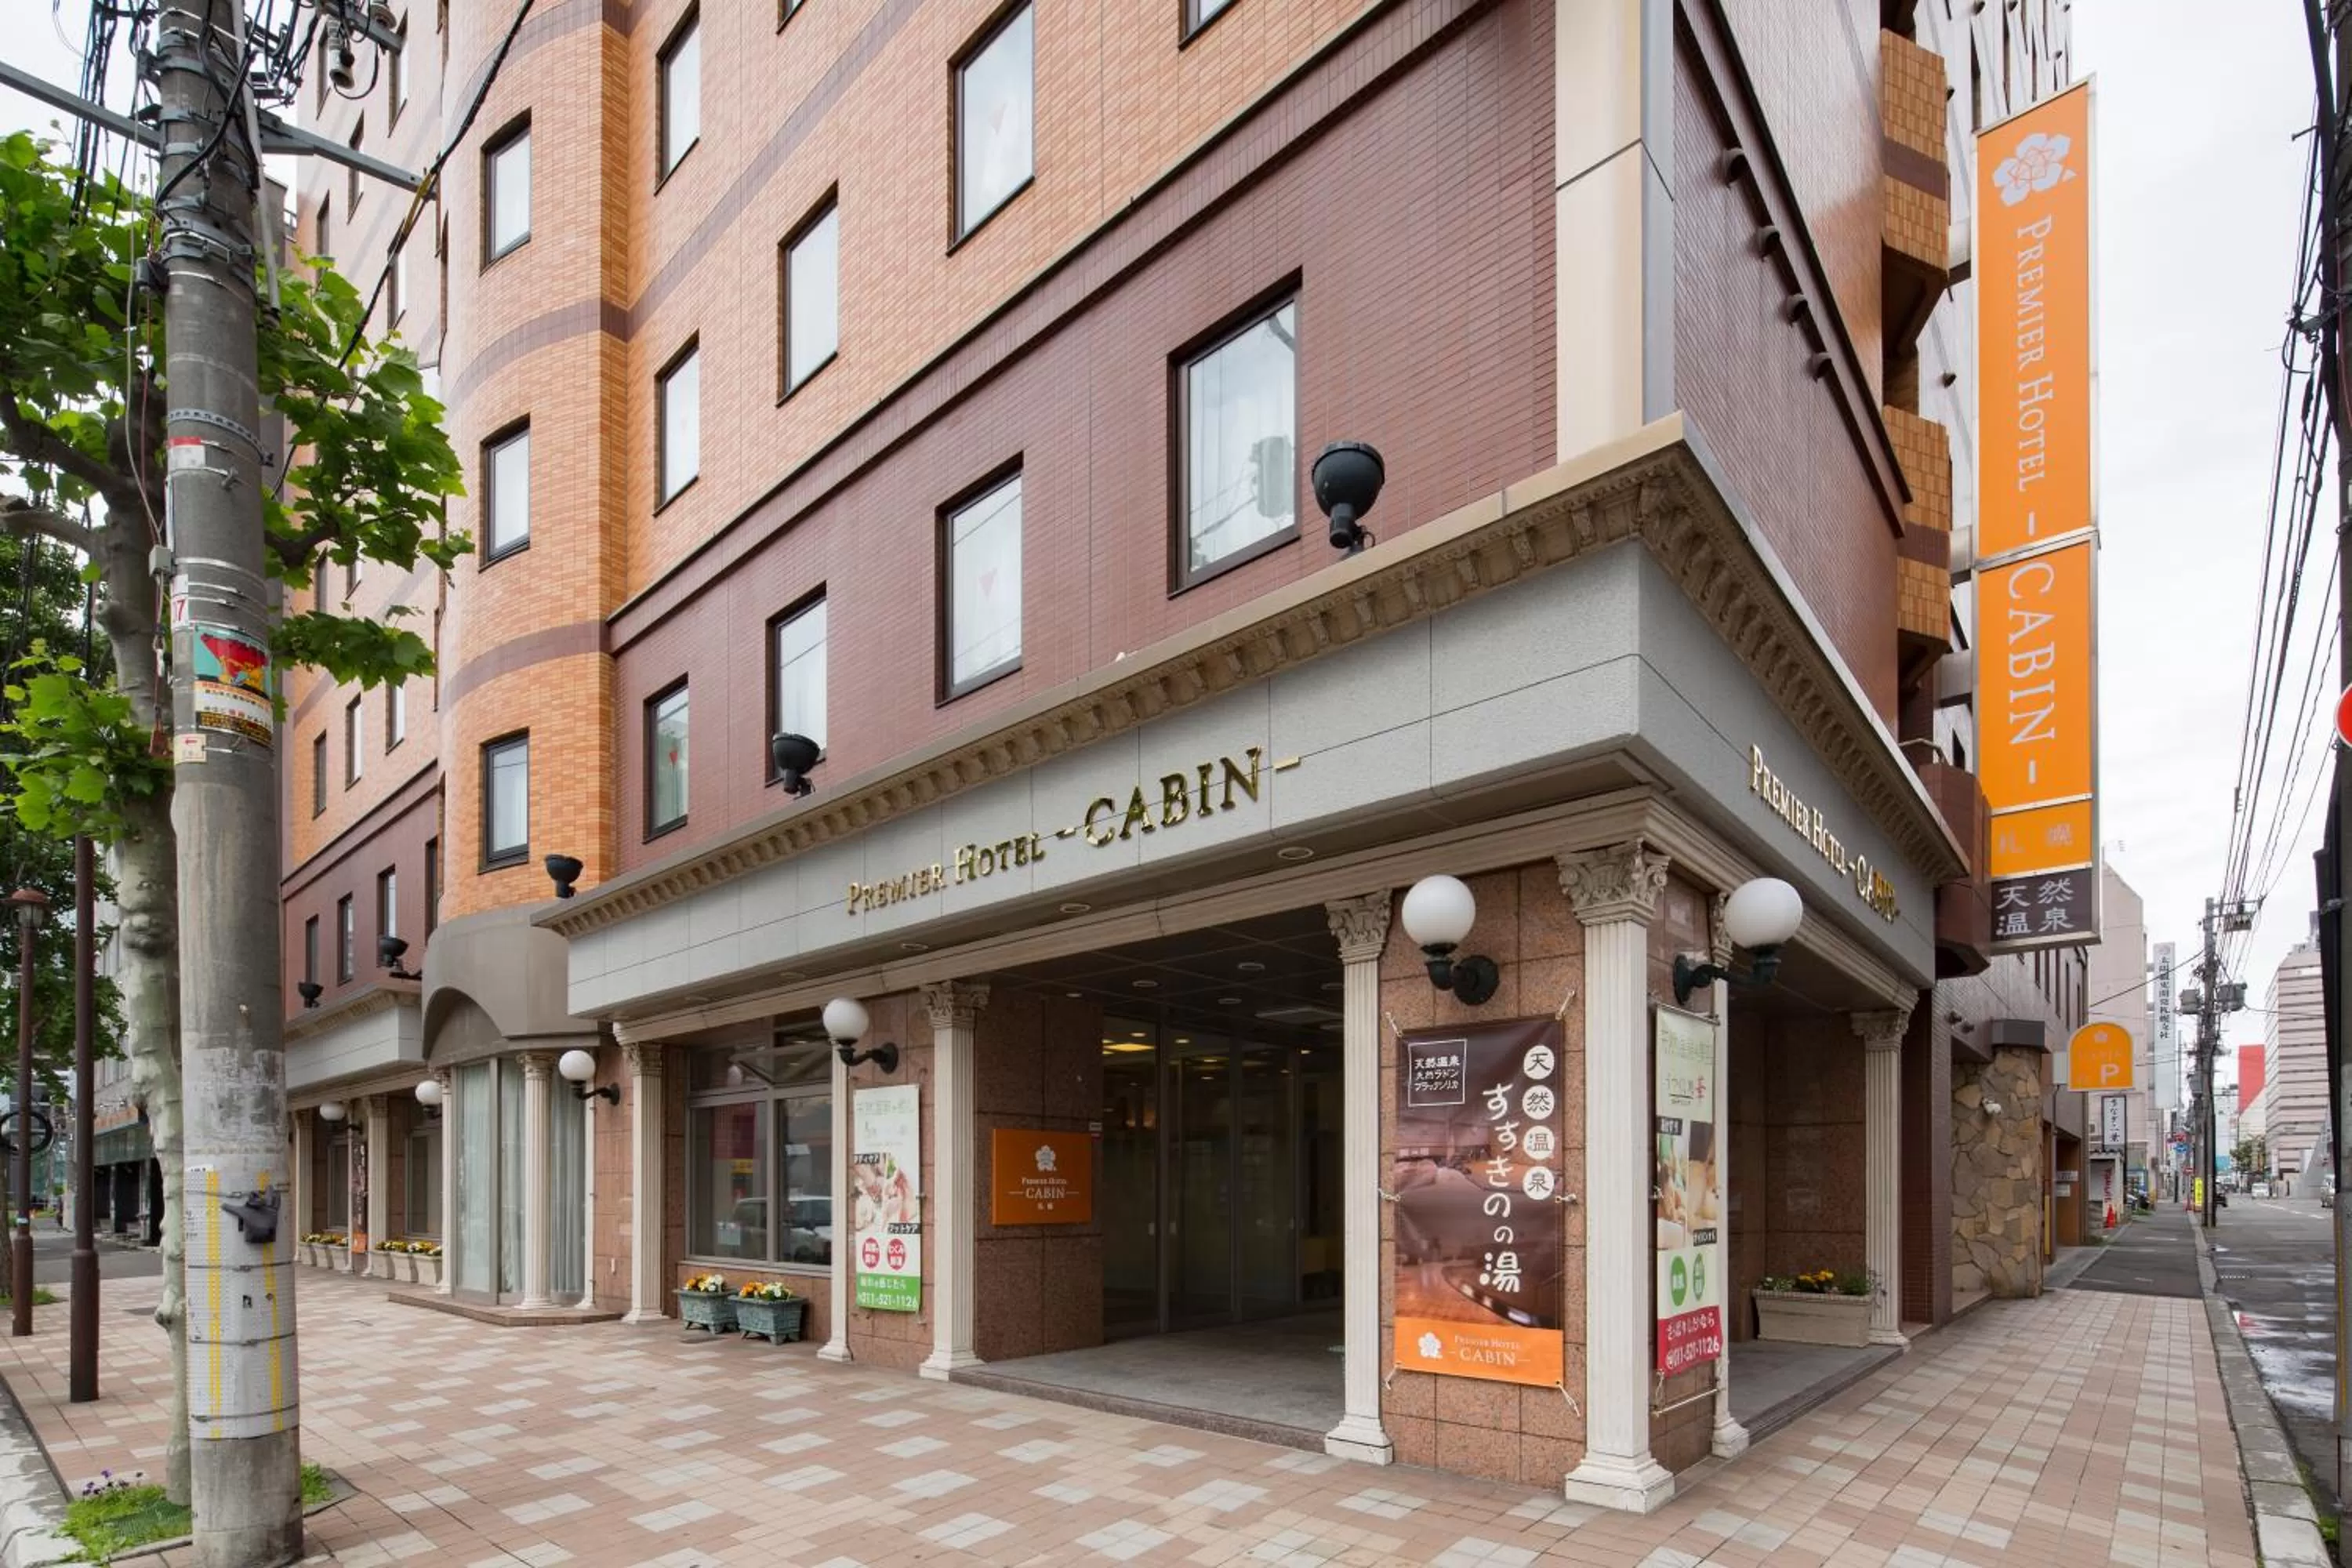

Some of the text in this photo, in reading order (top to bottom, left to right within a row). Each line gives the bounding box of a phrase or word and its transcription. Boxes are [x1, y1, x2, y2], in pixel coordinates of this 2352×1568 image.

[2017, 215, 2054, 493] PREMIER HOTEL
[846, 862, 946, 916] PREMIER
[954, 833, 1045, 885] HOTEL
[1749, 743, 1810, 840] PREMIER
[1812, 806, 1848, 879] HOTEL
[1524, 1047, 1553, 1196] 天然温泉
[2100, 1062, 2121, 1086] P
